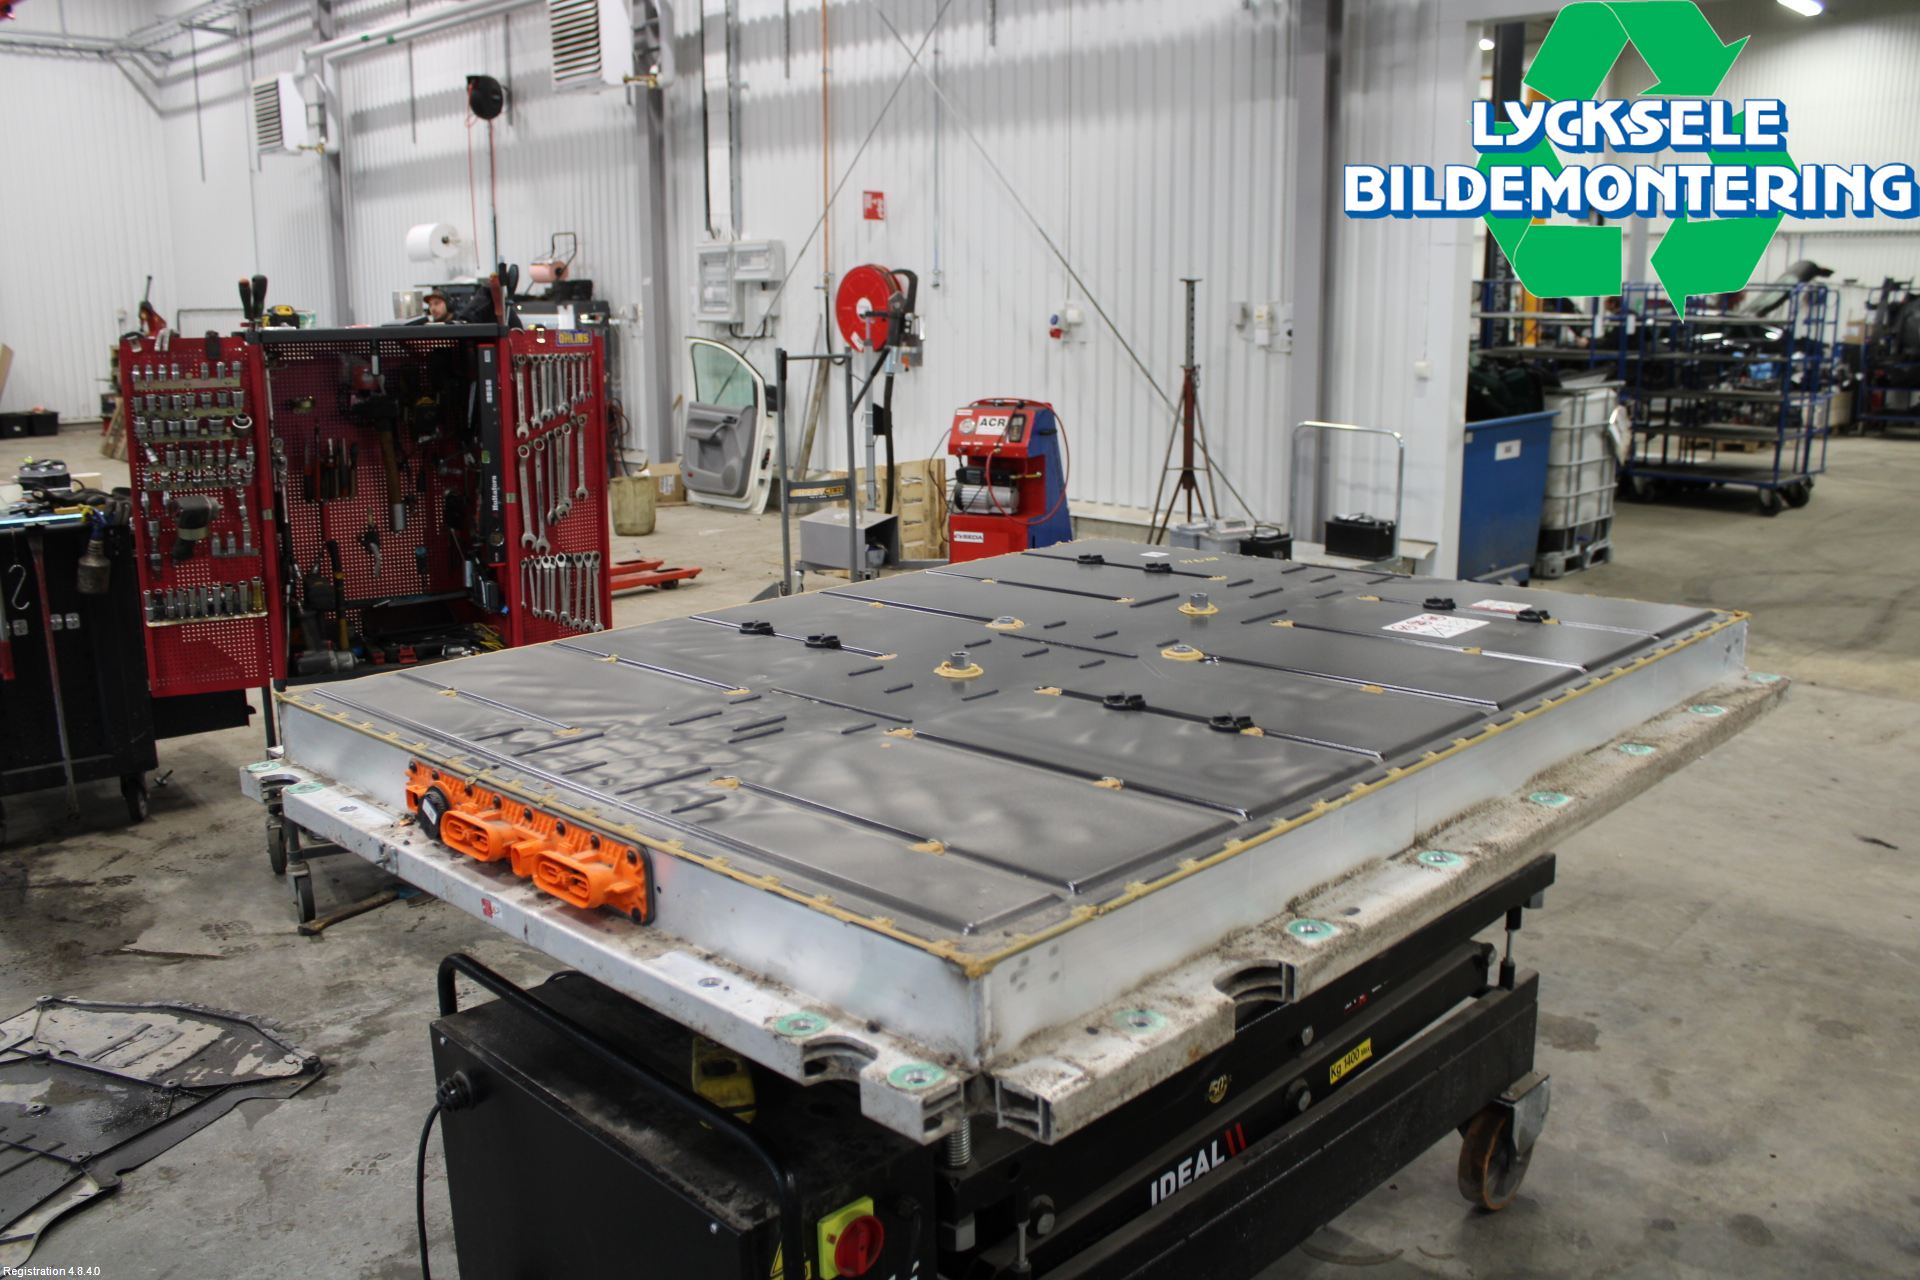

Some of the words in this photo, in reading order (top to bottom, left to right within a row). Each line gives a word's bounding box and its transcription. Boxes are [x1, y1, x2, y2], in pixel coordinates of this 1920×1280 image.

[980, 418, 1005, 427] ACR
[1330, 1064, 1342, 1080] Kg
[1344, 1048, 1360, 1069] 1400
[1151, 1139, 1225, 1206] IDEAL
